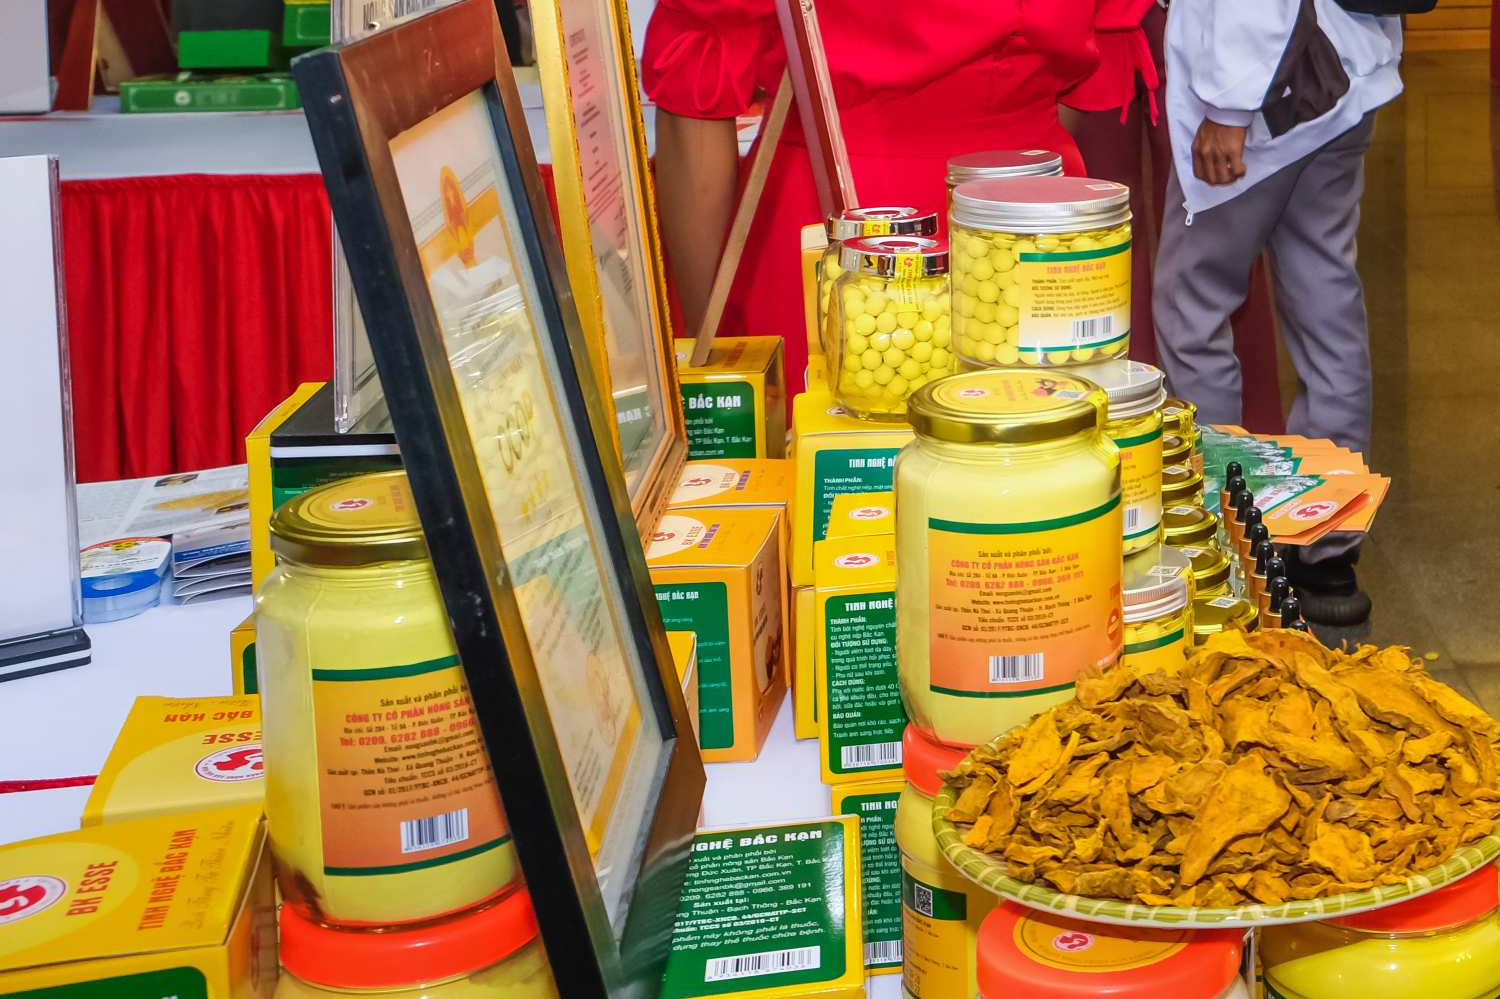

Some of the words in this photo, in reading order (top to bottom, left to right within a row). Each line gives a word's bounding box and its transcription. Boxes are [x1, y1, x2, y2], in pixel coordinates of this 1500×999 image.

[688, 393, 713, 409] BẮC
[716, 395, 741, 410] KẠN
[848, 458, 865, 468] TINH
[867, 456, 886, 469] NGHỆ
[972, 561, 979, 569] TY
[671, 589, 685, 600] BẮC
[686, 591, 699, 601] KẠN
[845, 601, 866, 612] TINH
[868, 597, 894, 610] NGHỆ
[212, 710, 254, 722] BẮC
[345, 710, 369, 724] CÔNG
[372, 712, 382, 723] TY
[861, 801, 882, 811] TINH
[740, 834, 778, 847] BẮC
[784, 830, 823, 842] KẠN
[152, 852, 189, 873] BẮC
[758, 862, 774, 870] Bắc
[76, 860, 118, 894] ESSE
[147, 874, 186, 904] NGHỆ
[65, 896, 103, 917] BK
[137, 905, 170, 931] TINH
[723, 929, 754, 937] không
